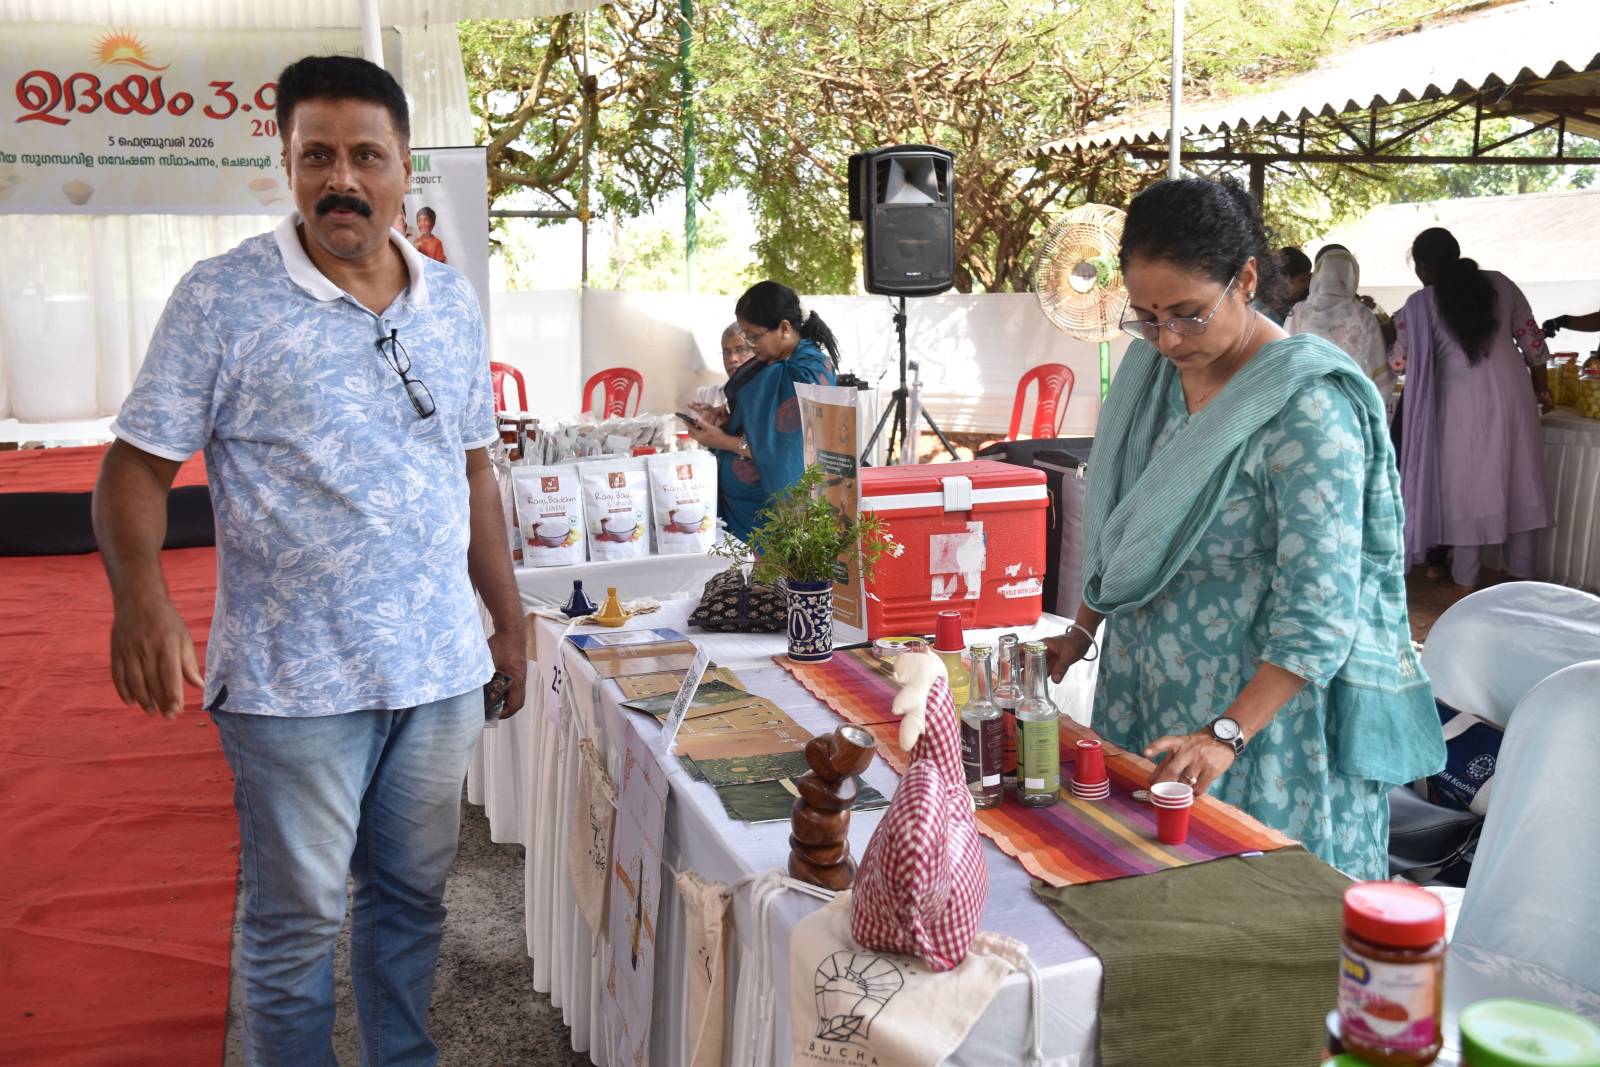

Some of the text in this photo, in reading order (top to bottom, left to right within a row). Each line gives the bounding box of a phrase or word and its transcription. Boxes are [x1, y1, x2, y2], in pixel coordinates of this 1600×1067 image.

[15, 70, 195, 126] ഉദയം
[250, 119, 278, 137] 20
[108, 136, 116, 147] 5
[188, 137, 215, 148] 2026
[410, 176, 442, 184] RODUCT
[1450, 778, 1478, 796] Kozhik
[808, 1040, 879, 1066] BUCHA
